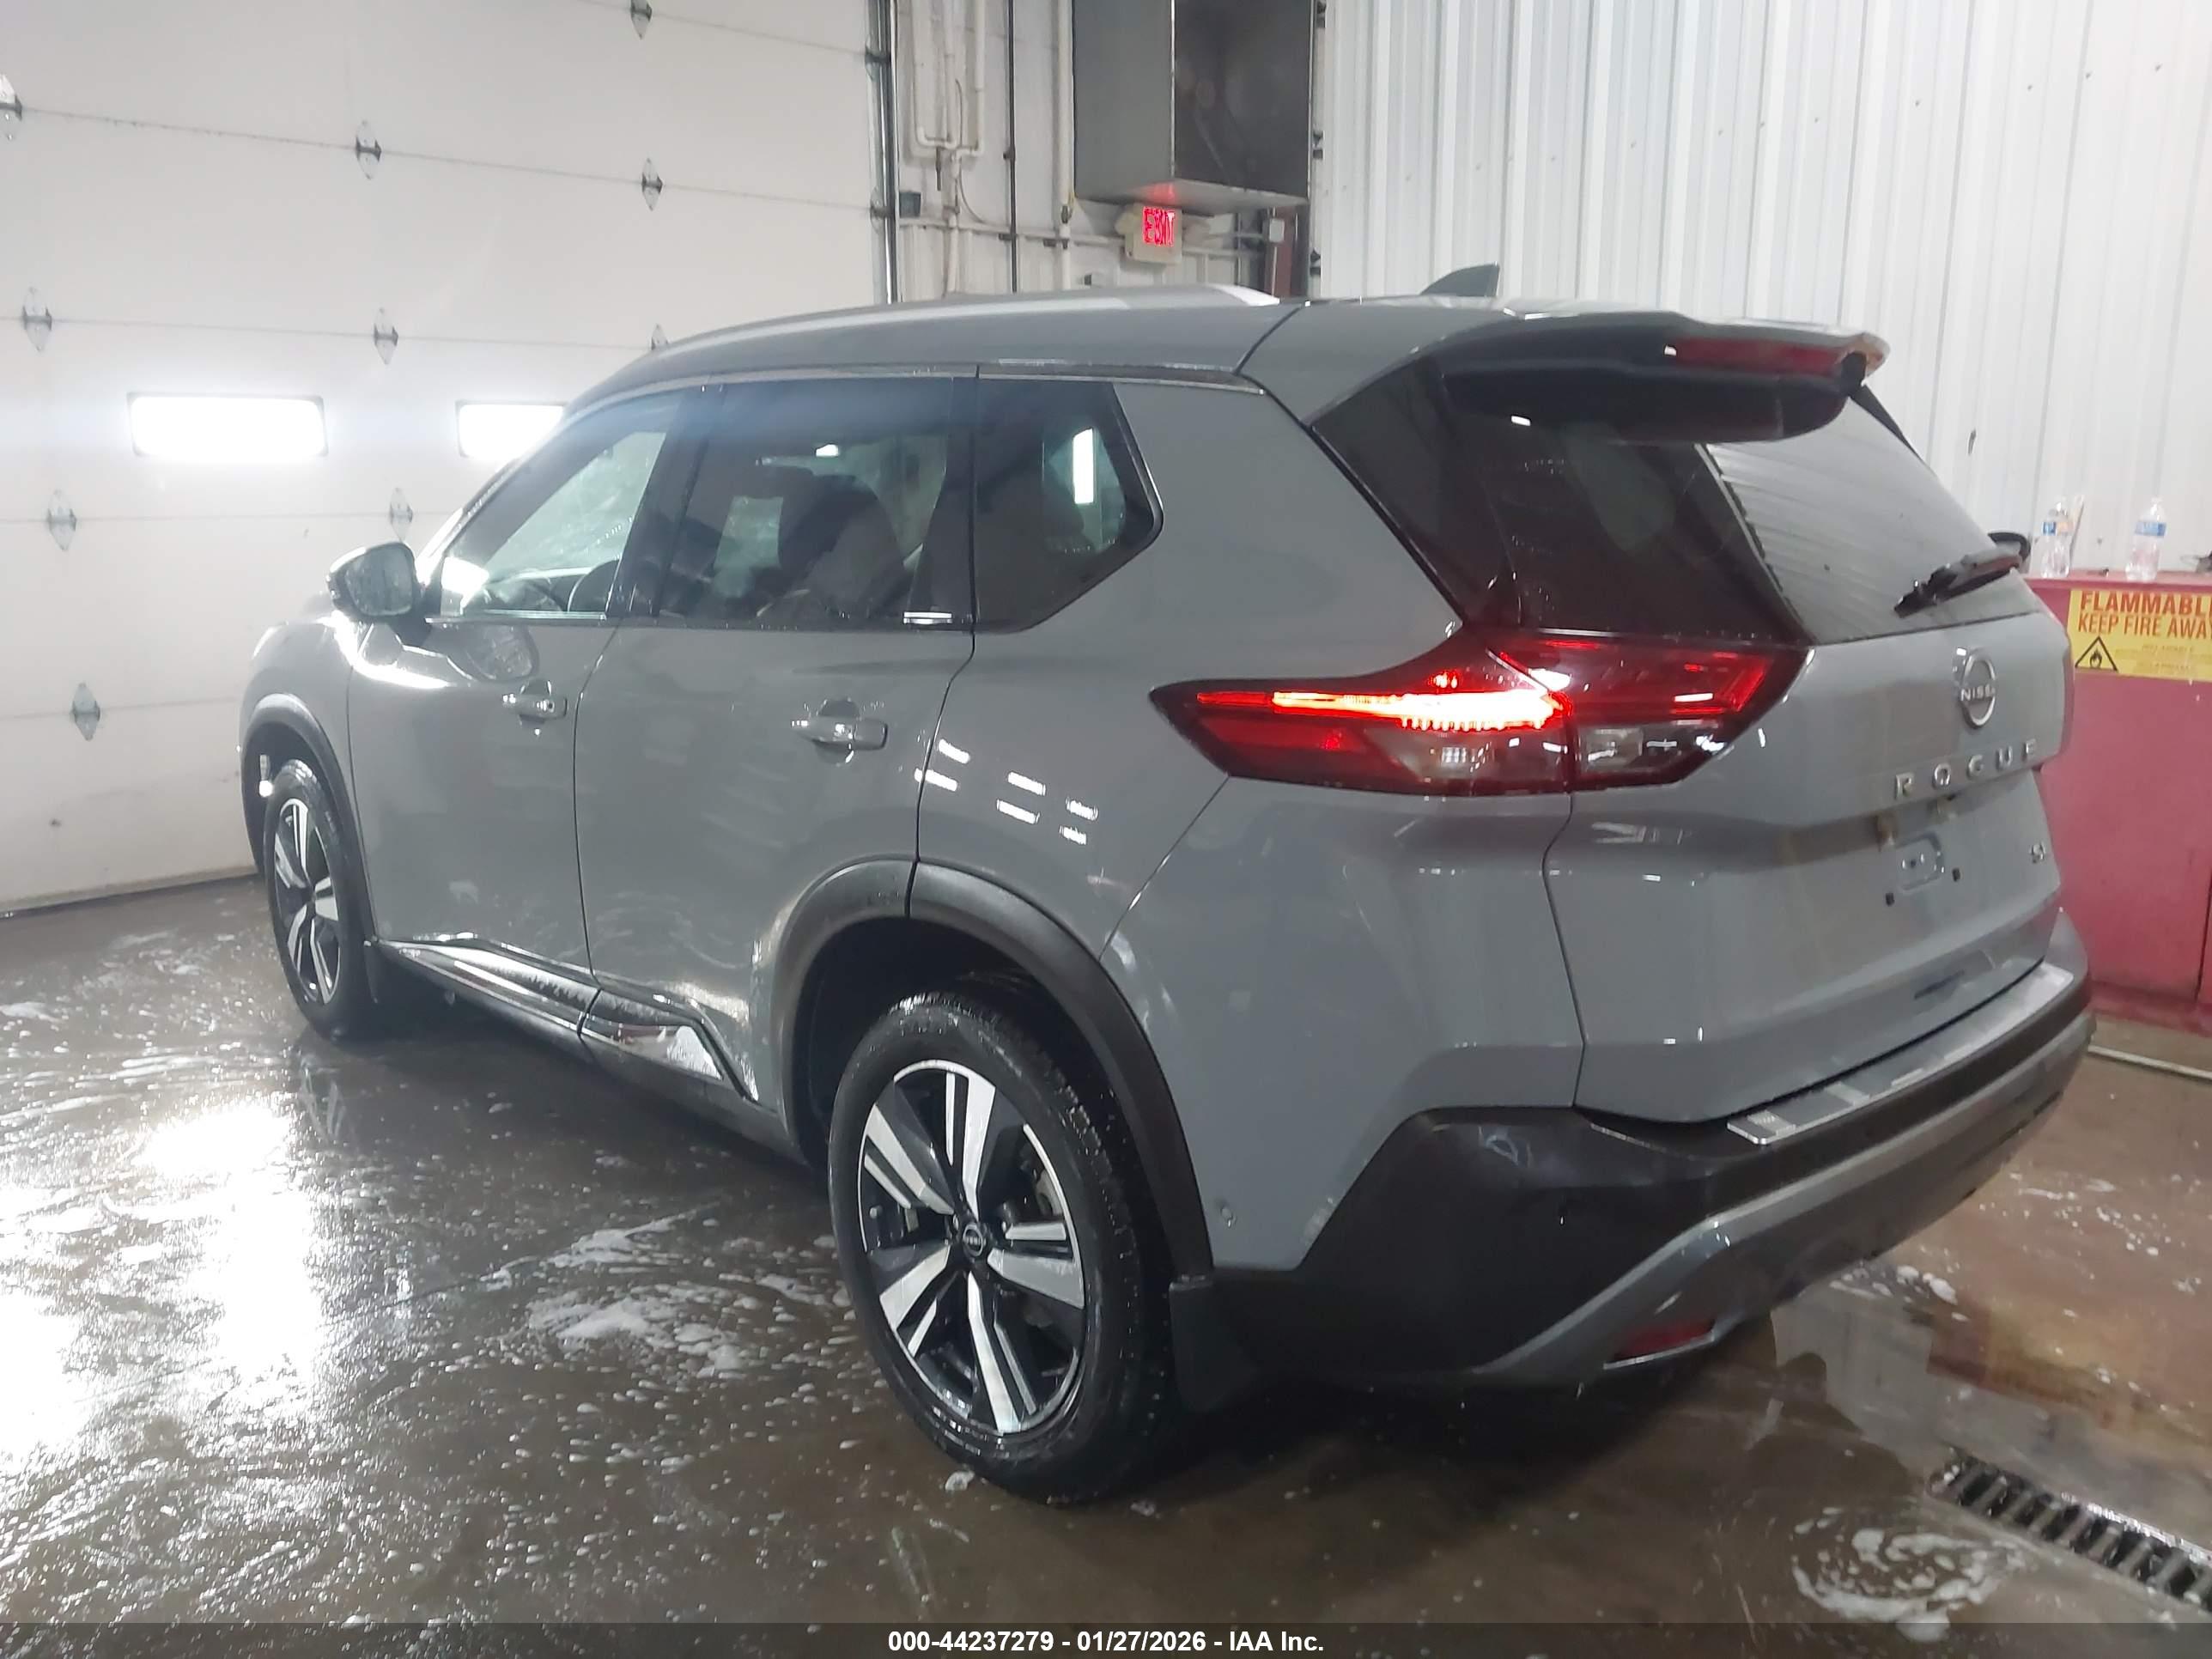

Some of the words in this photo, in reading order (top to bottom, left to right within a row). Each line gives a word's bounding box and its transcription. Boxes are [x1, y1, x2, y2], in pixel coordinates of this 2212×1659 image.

[1143, 207, 1175, 246] EXIT
[2078, 611, 2119, 635] KEEP
[2124, 615, 2162, 636] FIRE
[1895, 738, 2036, 799] ROGUE
